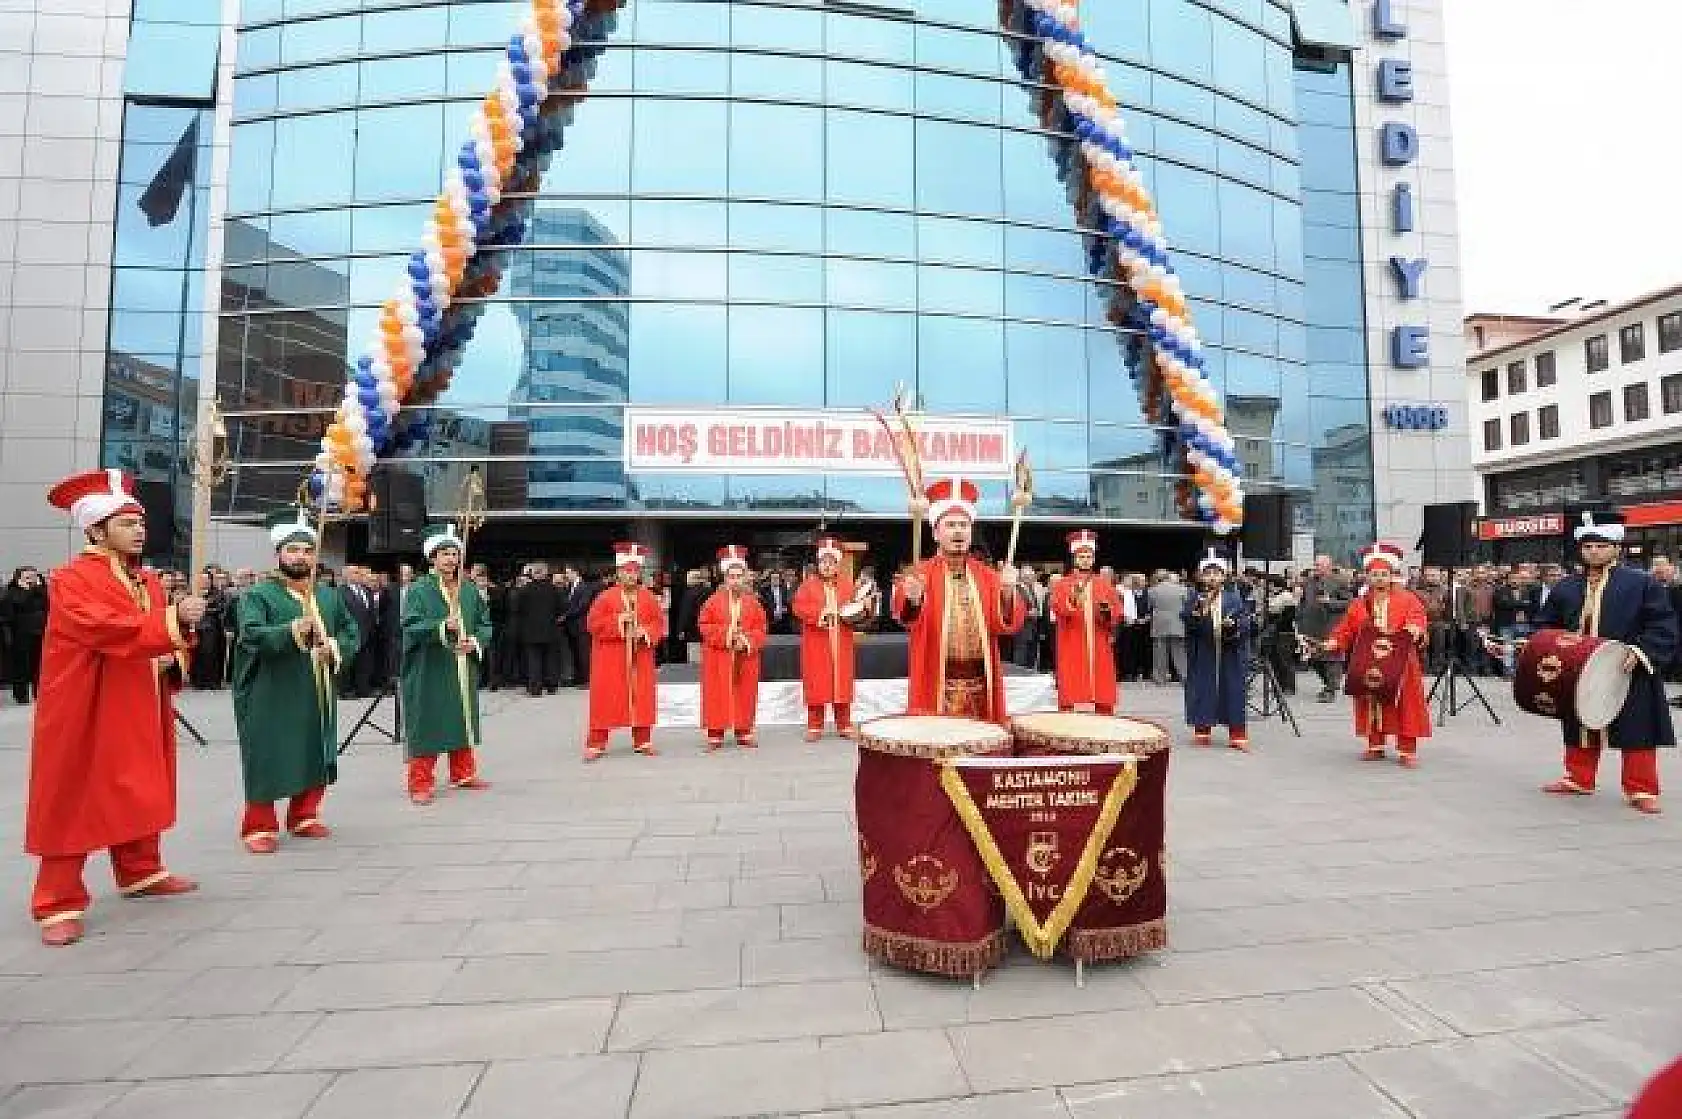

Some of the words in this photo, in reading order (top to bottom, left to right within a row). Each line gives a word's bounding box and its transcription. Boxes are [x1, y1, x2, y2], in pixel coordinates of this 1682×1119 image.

[636, 423, 698, 463] HOŞ
[707, 420, 843, 459] GELDİNİZ
[852, 428, 1004, 463] BAKANIM
